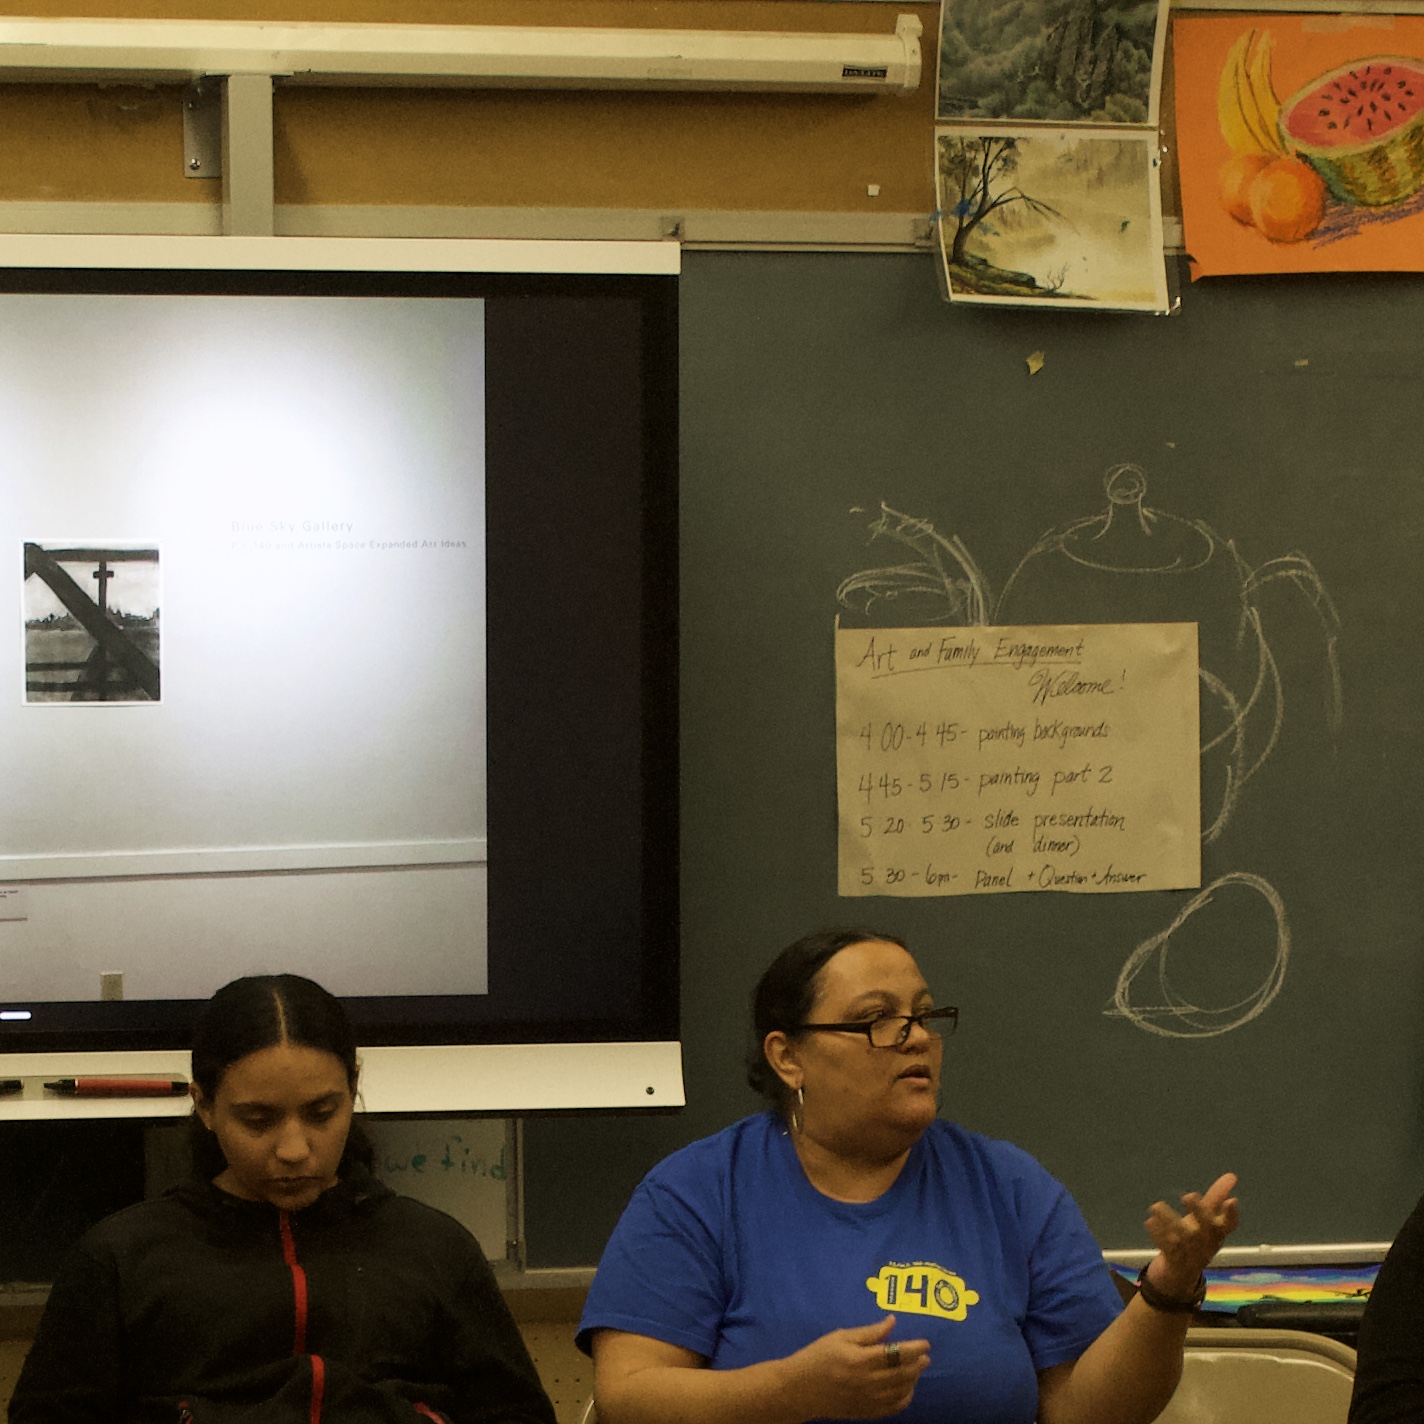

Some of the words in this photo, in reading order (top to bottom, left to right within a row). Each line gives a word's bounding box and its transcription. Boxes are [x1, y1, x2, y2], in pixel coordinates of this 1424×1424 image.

[270, 521, 295, 534] Sky
[303, 521, 353, 533] Gallery
[370, 540, 417, 550] Expanded
[421, 540, 436, 549] Art
[441, 540, 467, 548] Ideas
[856, 637, 896, 672] Art
[909, 643, 931, 660] and
[938, 636, 982, 668] Family
[994, 637, 1085, 669] Engagement
[978, 721, 1026, 752] painting
[1033, 718, 1110, 749] backgrounds
[978, 766, 1040, 797] painting
[1051, 763, 1092, 796] part
[1098, 765, 1113, 783] 2
[984, 809, 1020, 830] slide
[1033, 806, 1125, 844] presentation
[975, 866, 1013, 888] Panel
[1096, 864, 1148, 885] Answer
[885, 1275, 959, 1311] 140
